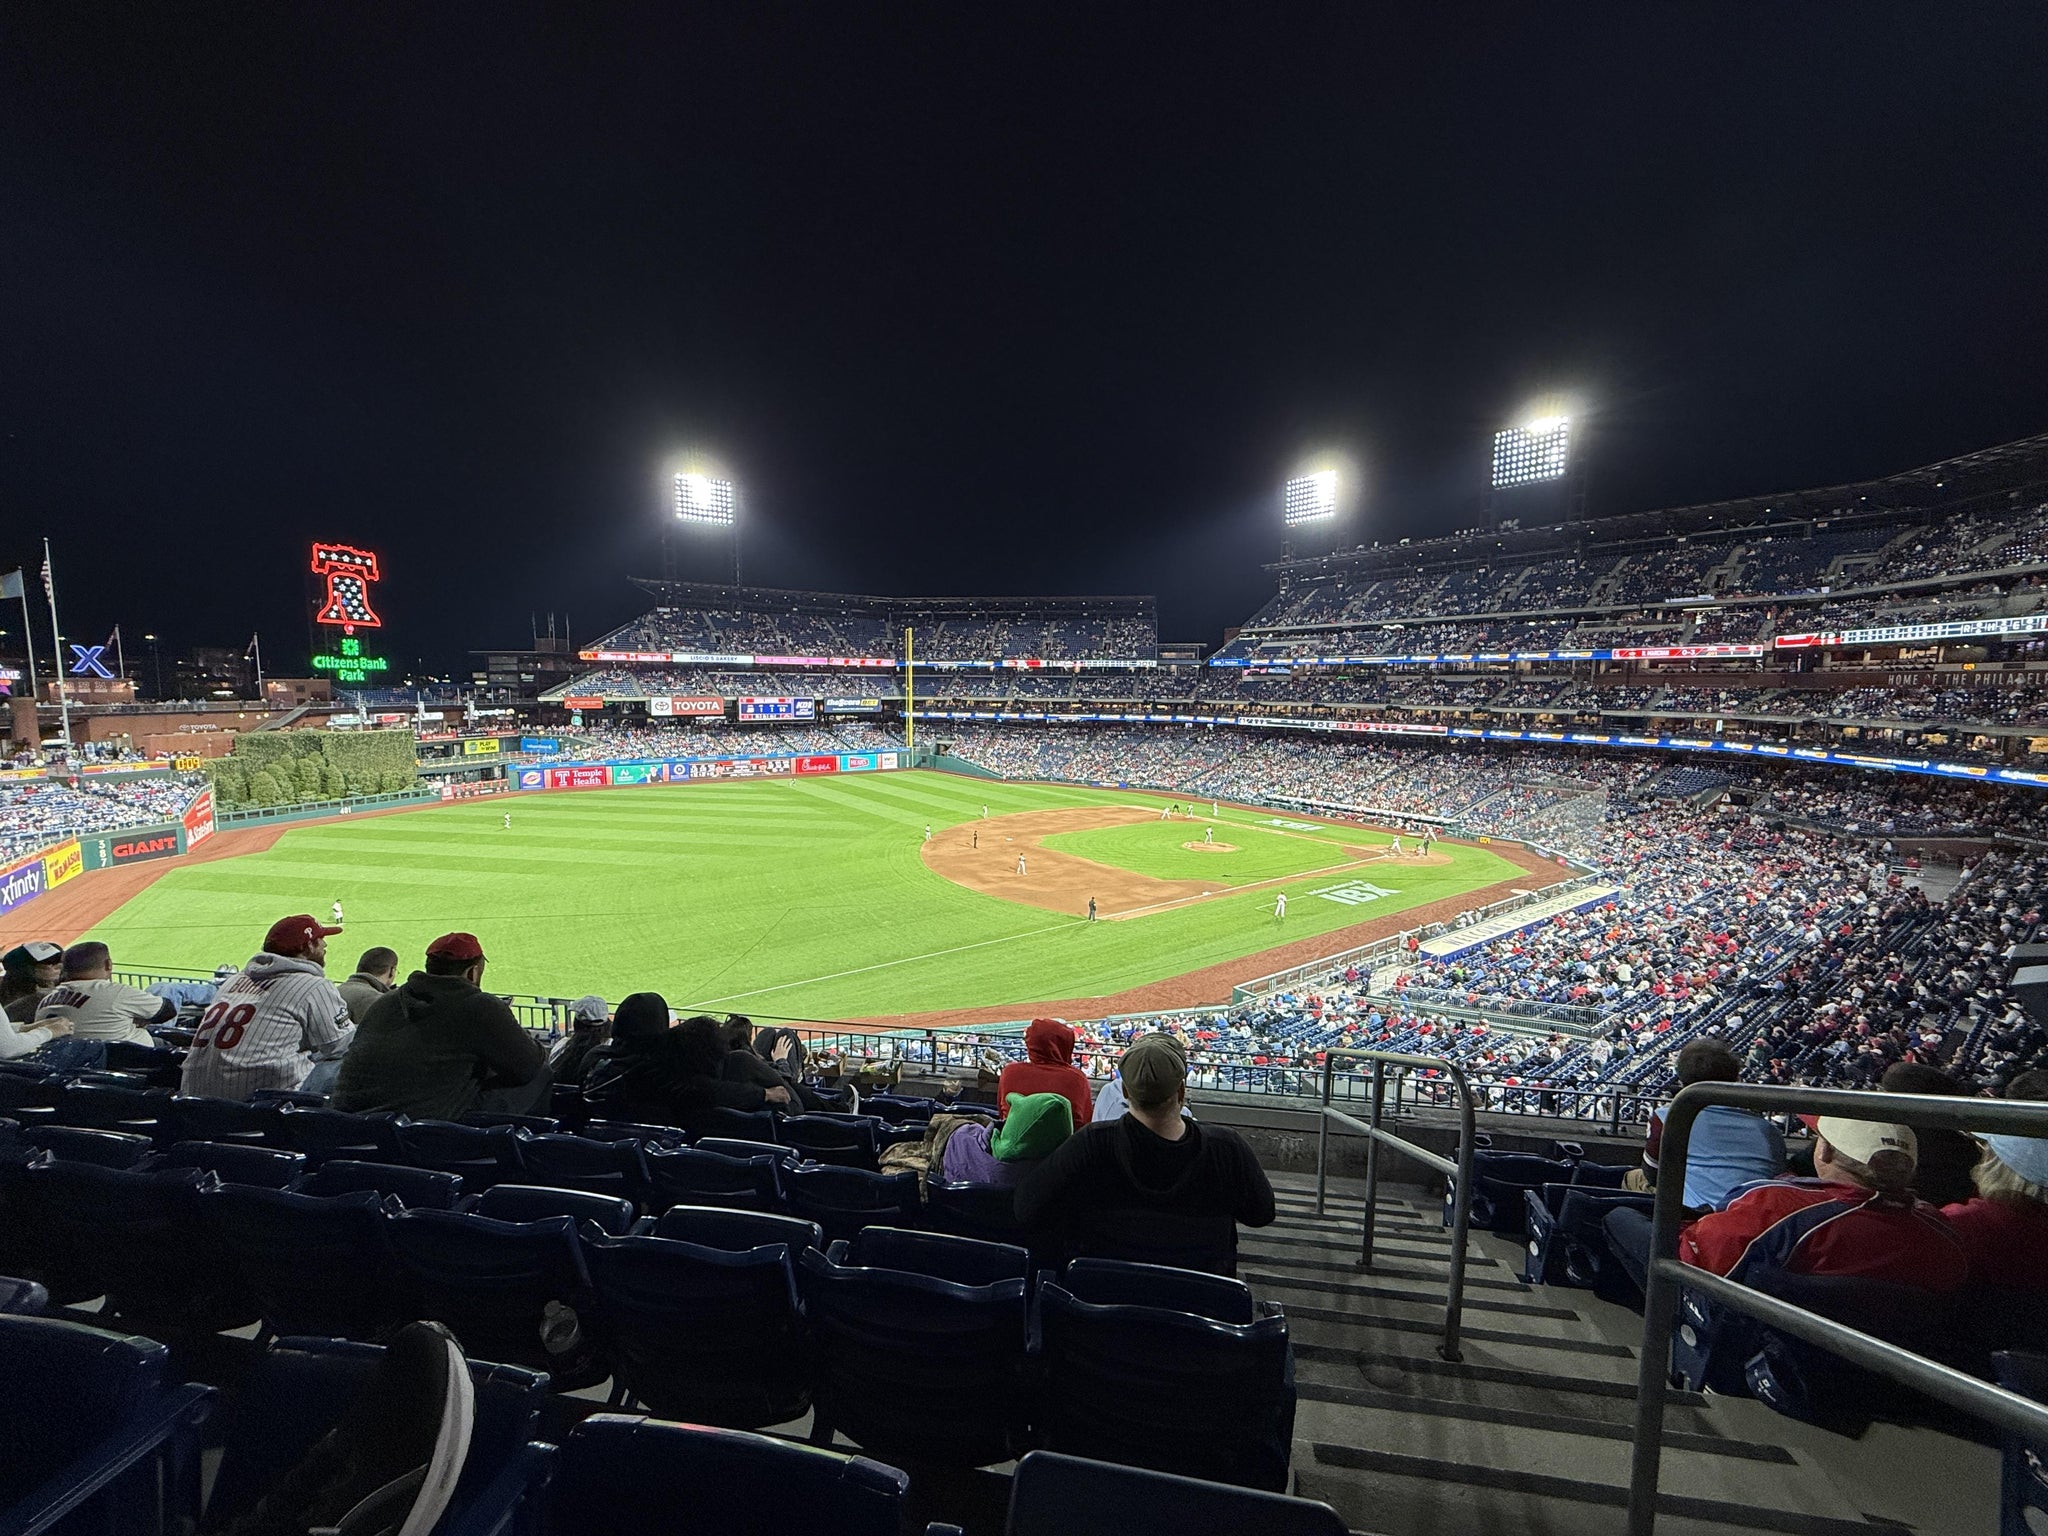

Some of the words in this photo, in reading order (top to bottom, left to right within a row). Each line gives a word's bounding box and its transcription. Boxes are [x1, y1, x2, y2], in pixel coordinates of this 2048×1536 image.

[1963, 624, 1971, 633] R
[1987, 622, 1996, 631] H
[2013, 620, 2020, 630] E
[312, 655, 359, 669] Citizens
[359, 657, 387, 670] Bank
[339, 669, 365, 682] Park
[1888, 673, 1919, 686] HOME
[1944, 673, 1967, 685] THE
[674, 701, 720, 711] TOYOTA
[572, 769, 603, 778] Temple
[573, 776, 602, 786] Health
[98, 839, 108, 868] 387
[112, 836, 177, 858] GIANT
[1, 868, 40, 906] xfinity
[1318, 883, 1403, 906] IBX
[191, 1001, 257, 1050] 28
